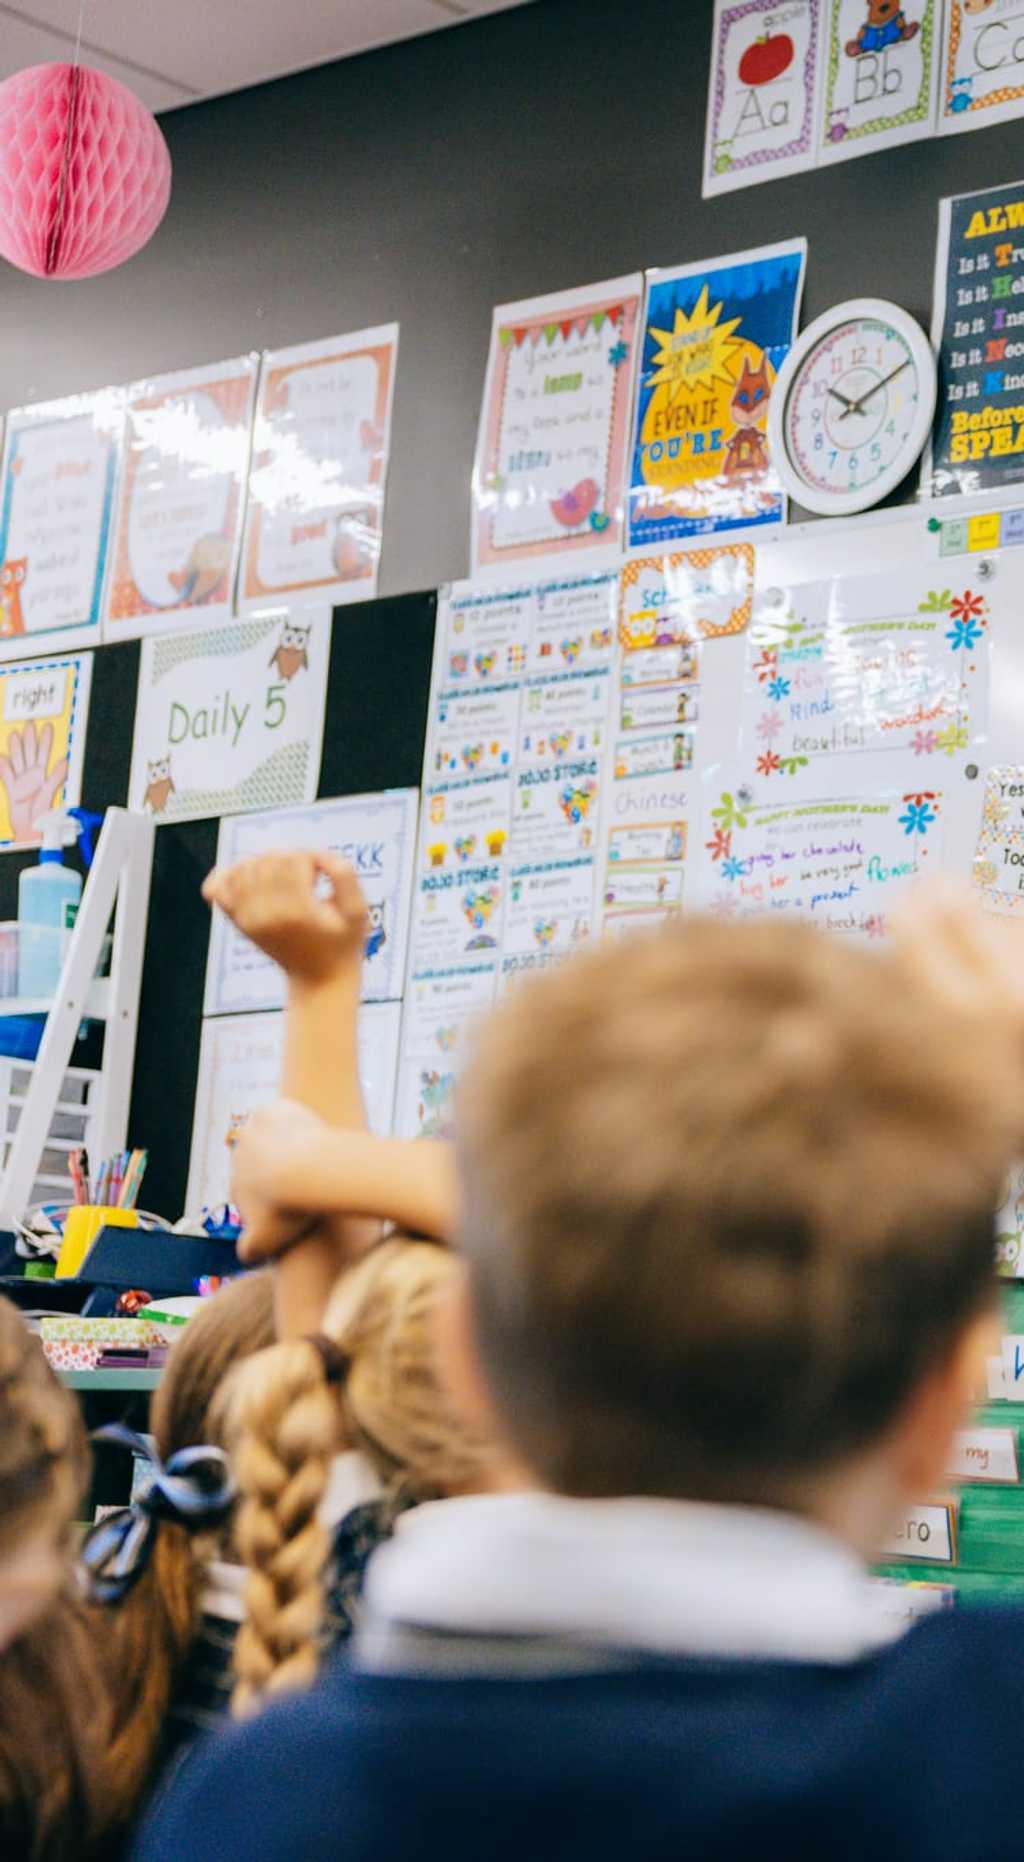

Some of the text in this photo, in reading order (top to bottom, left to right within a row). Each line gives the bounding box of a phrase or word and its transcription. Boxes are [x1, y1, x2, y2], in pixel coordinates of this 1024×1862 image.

[853, 51, 902, 104] Bb
[734, 87, 789, 137] Aa
[957, 256, 974, 276] Is
[976, 253, 991, 271] it
[956, 288, 973, 307] Is
[975, 285, 989, 302] it
[953, 321, 970, 338] Is
[972, 317, 986, 335] it
[851, 346, 867, 366] 12
[950, 351, 967, 369] Is
[968, 348, 982, 365] it
[947, 384, 964, 402] Is
[966, 381, 980, 398] it
[653, 396, 719, 438] EVEN IF
[884, 420, 895, 437] 4
[814, 433, 824, 451] 8
[827, 450, 838, 470] 7
[849, 451, 858, 470] 6
[11, 682, 57, 719] right
[167, 684, 288, 747] Daily 5
[614, 788, 689, 815] Chinese
[965, 1446, 990, 1470] my
